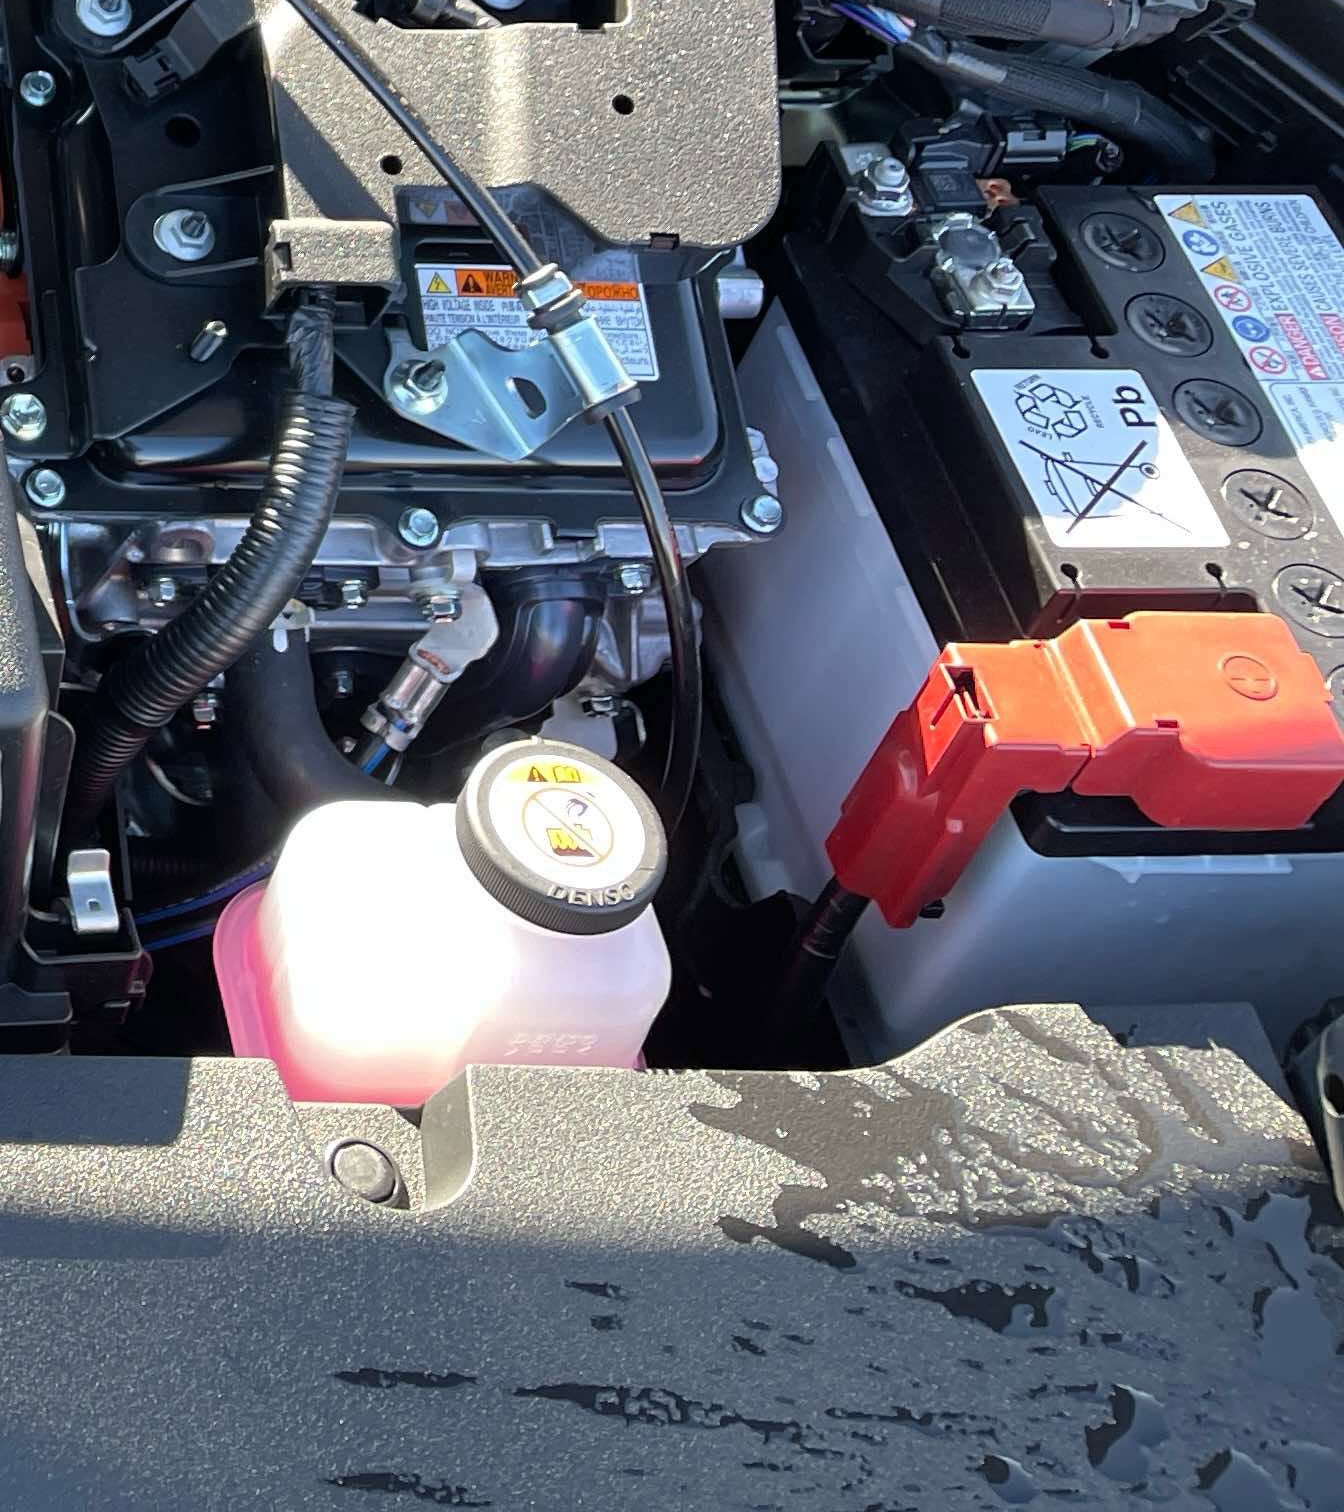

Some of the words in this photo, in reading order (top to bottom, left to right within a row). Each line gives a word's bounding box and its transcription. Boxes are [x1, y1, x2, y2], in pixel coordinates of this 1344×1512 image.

[1212, 201, 1245, 241] GASES
[1255, 201, 1286, 234] BURNS
[1276, 236, 1309, 271] SEVERE
[1235, 245, 1289, 312] EXPLOSIVE
[1298, 272, 1332, 312] CAUSES
[441, 299, 470, 311] VOLTAGE
[1280, 316, 1319, 366] DANGER
[1112, 385, 1158, 427] Pb
[1027, 425, 1053, 441] LEAD
[547, 883, 635, 907] DENSO
